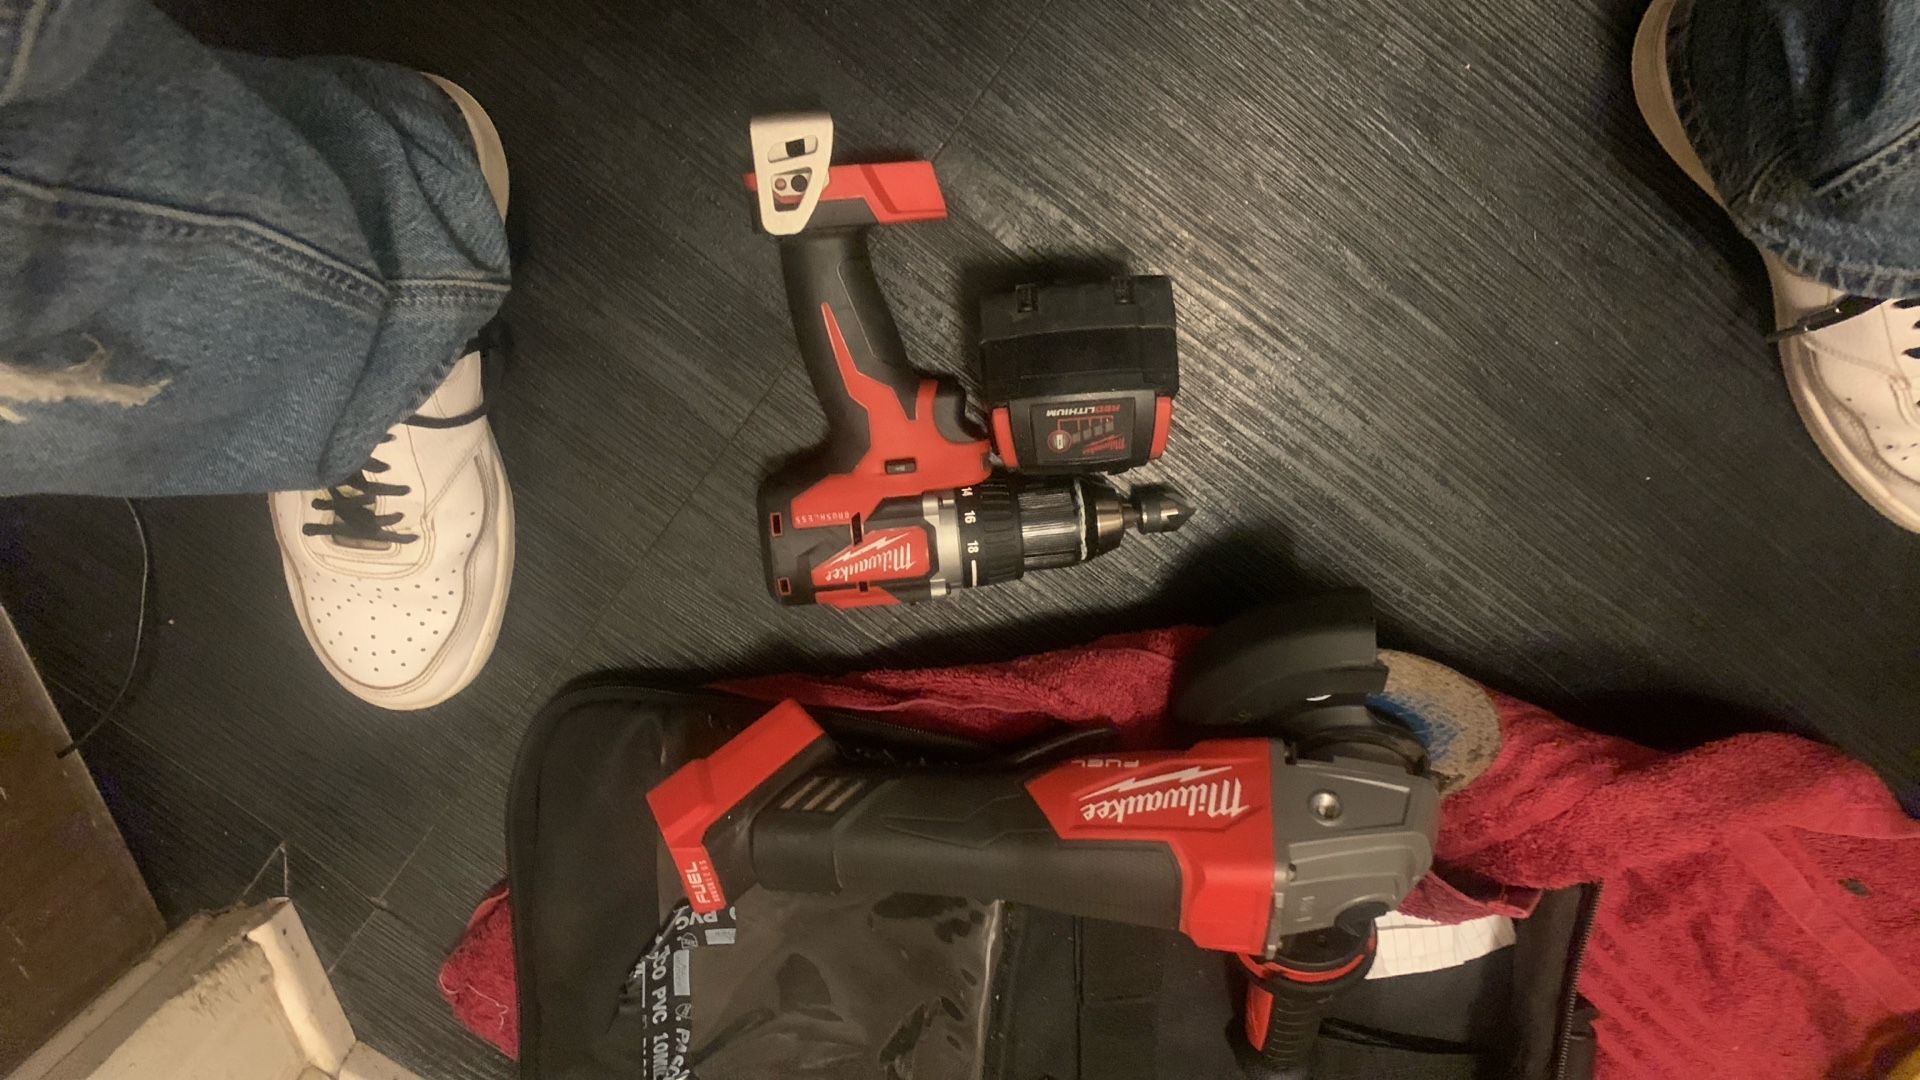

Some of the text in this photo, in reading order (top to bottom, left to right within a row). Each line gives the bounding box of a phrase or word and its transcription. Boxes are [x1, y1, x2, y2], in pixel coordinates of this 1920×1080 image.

[1046, 404, 1120, 417] REDLITHIUM
[962, 487, 974, 498] 14
[796, 511, 850, 525] BRUSHLESS
[964, 510, 975, 524] 16
[967, 540, 979, 554] 18
[825, 544, 916, 584] Milwaukee
[1071, 759, 1139, 769] FUEL
[1079, 777, 1250, 824] Milwaukee
[685, 860, 711, 905] FUEL
[652, 986, 667, 1024] PVC
